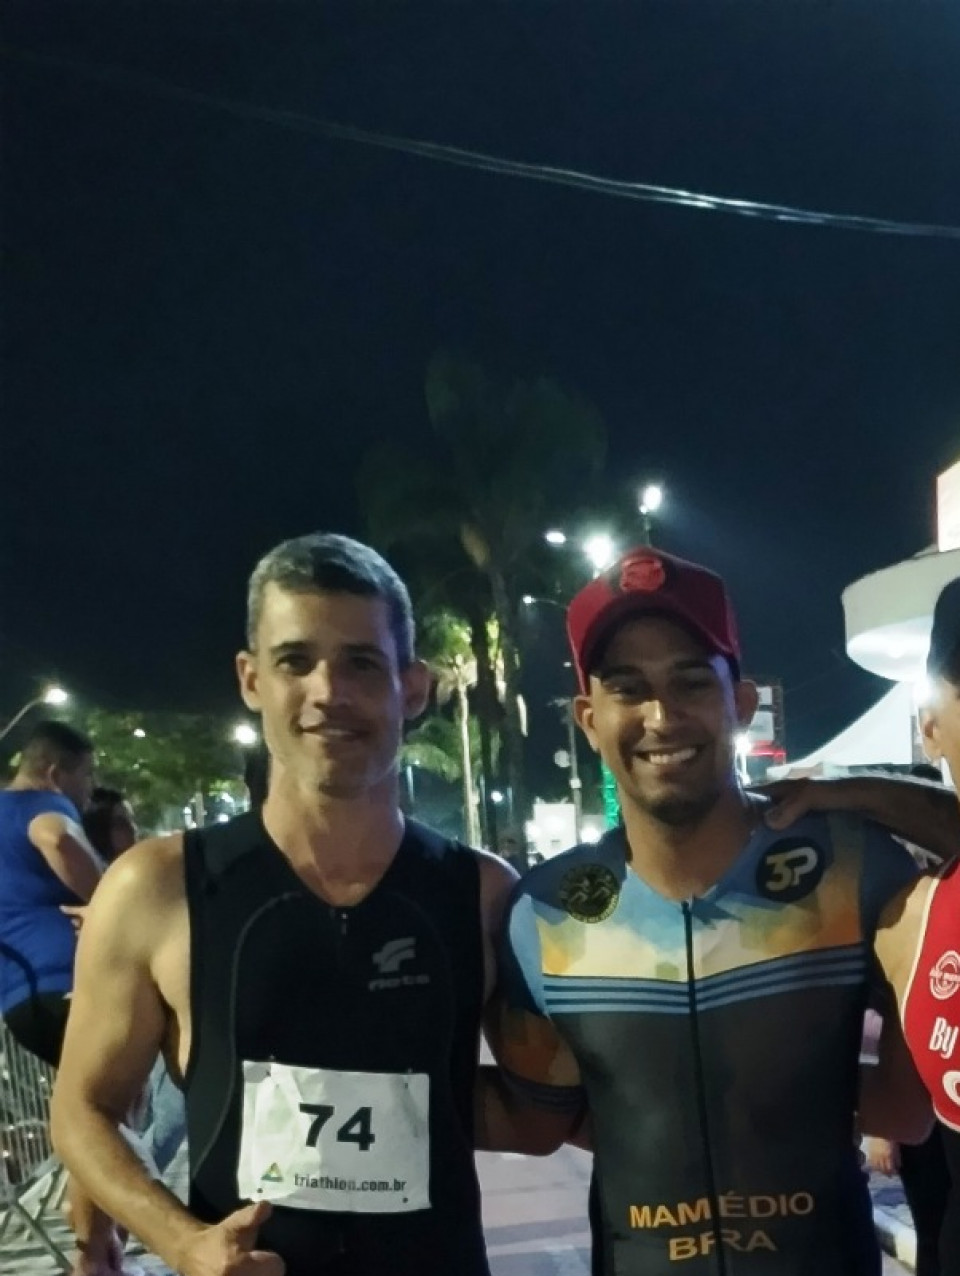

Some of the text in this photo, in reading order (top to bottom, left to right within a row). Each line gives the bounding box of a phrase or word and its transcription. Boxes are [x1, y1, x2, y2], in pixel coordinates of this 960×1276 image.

[929, 1017, 959, 1060] By
[298, 1102, 376, 1151] 74
[294, 1173, 408, 1192] triathlon.com.br
[629, 1190, 814, 1229] MAMÉDIO
